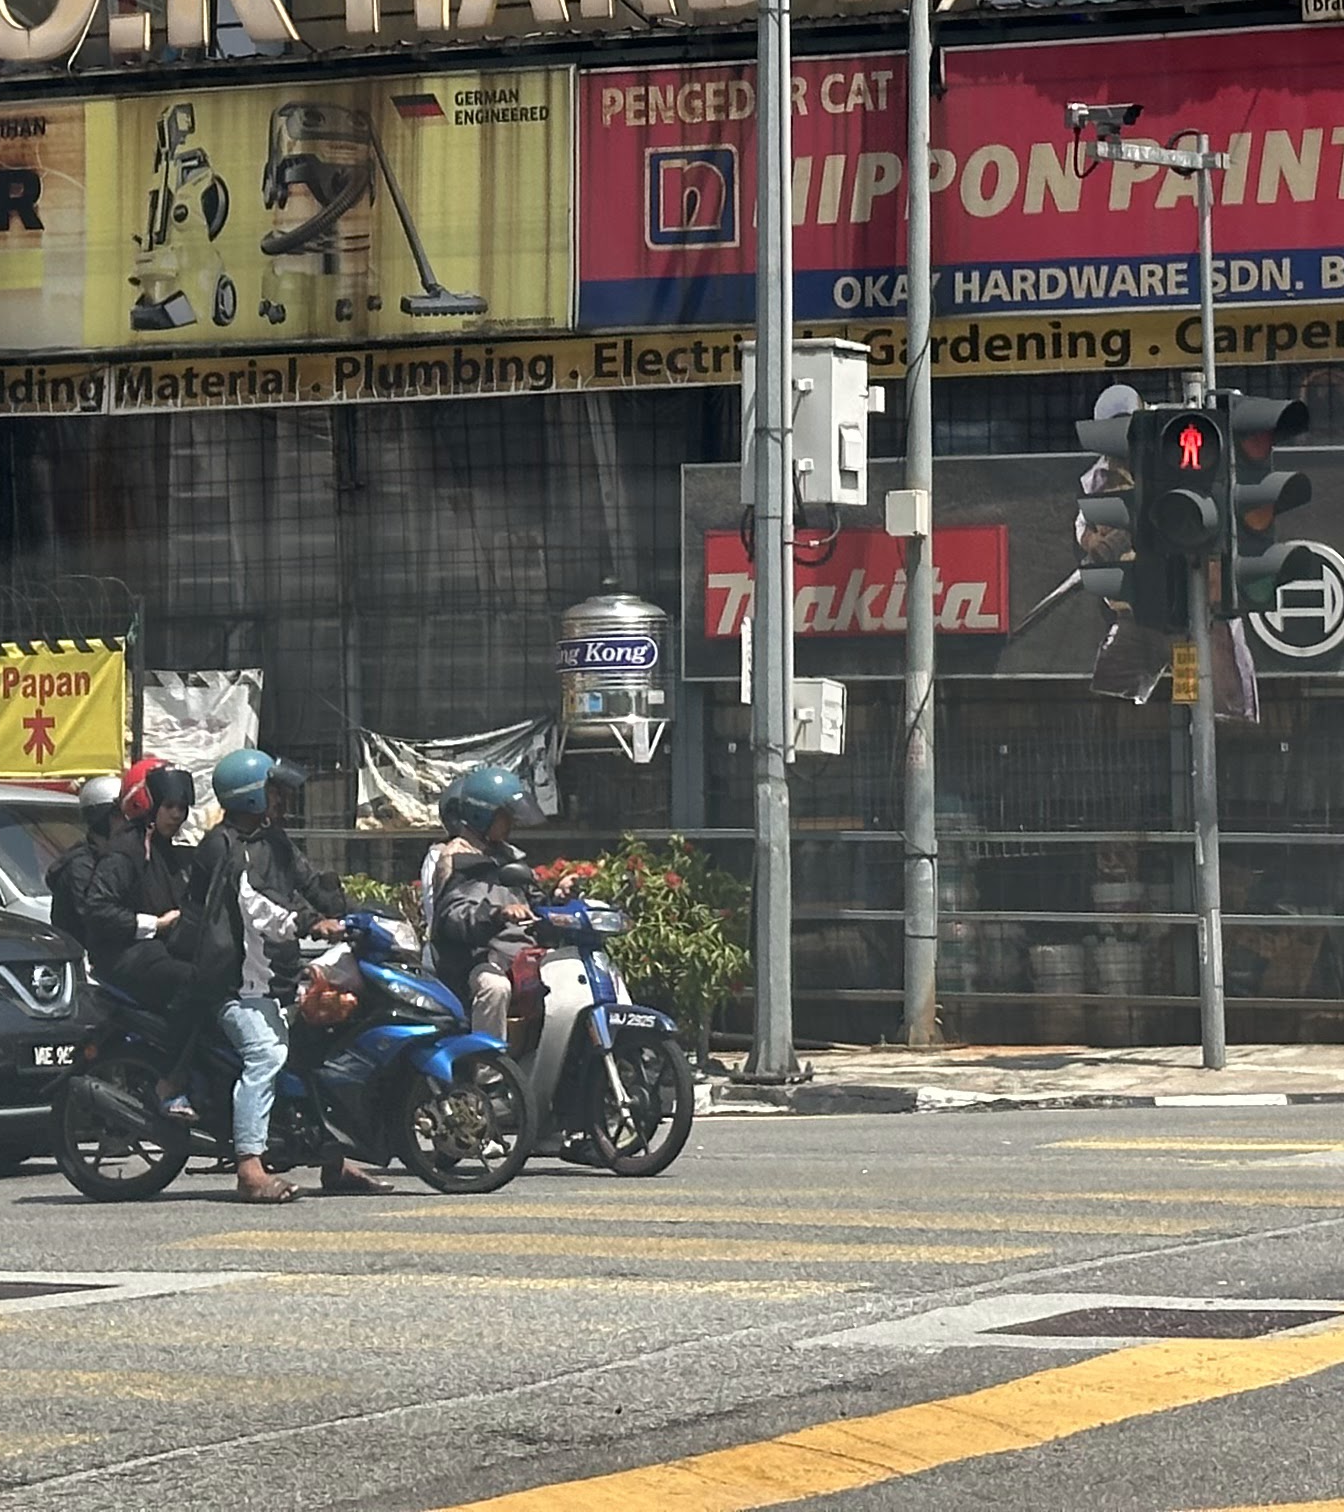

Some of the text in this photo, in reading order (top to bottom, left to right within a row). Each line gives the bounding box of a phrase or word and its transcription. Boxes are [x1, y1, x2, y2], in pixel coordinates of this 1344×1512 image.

[454, 88, 520, 107] GERMAN
[454, 106, 550, 126] ENGINEERED
[601, 70, 893, 126] PENGEDR CAT
[955, 261, 1189, 304] HARDWARE
[1209, 257, 1304, 296] SDN.
[115, 356, 298, 404] Material
[334, 349, 555, 398] Plumbing
[593, 334, 745, 380] Electri
[708, 567, 999, 635] Makia
[584, 641, 647, 664] Kong
[1, 665, 91, 707] Papan
[22, 707, 56, 765] 木
